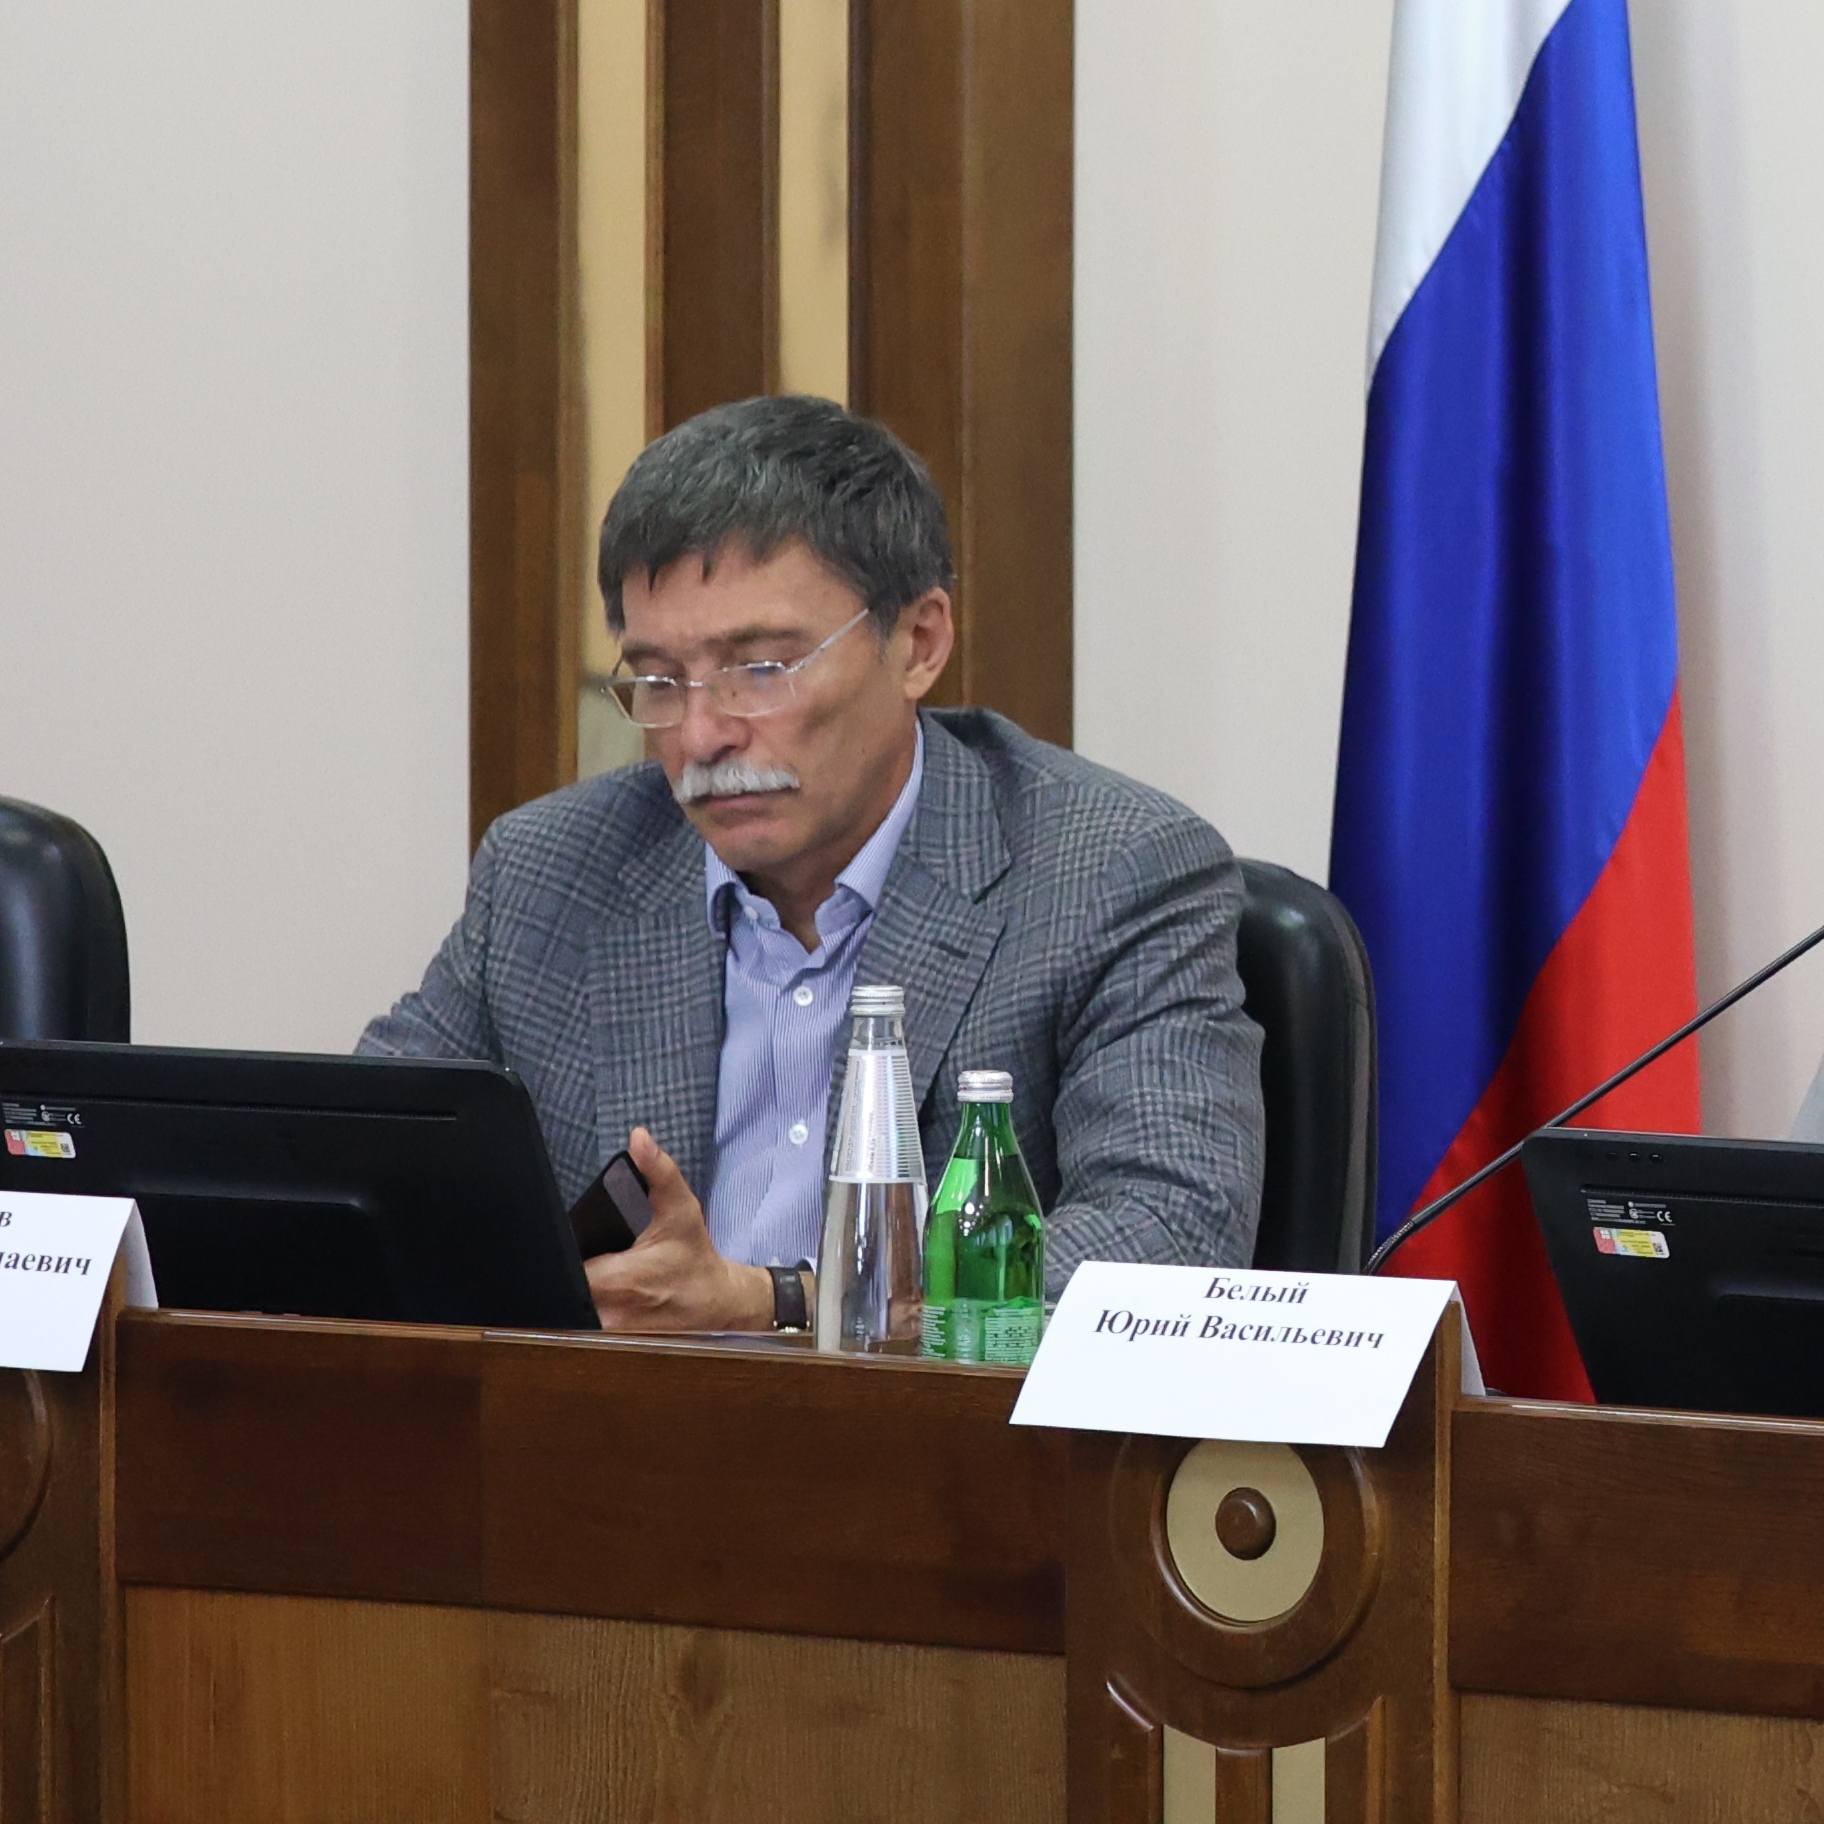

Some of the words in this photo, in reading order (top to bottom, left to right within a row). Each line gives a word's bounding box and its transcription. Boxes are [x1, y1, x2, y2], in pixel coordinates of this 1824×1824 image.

[1203, 1276, 1310, 1304] Белый
[1093, 1309, 1191, 1342] Юрий
[1198, 1315, 1385, 1349] Васильевич
